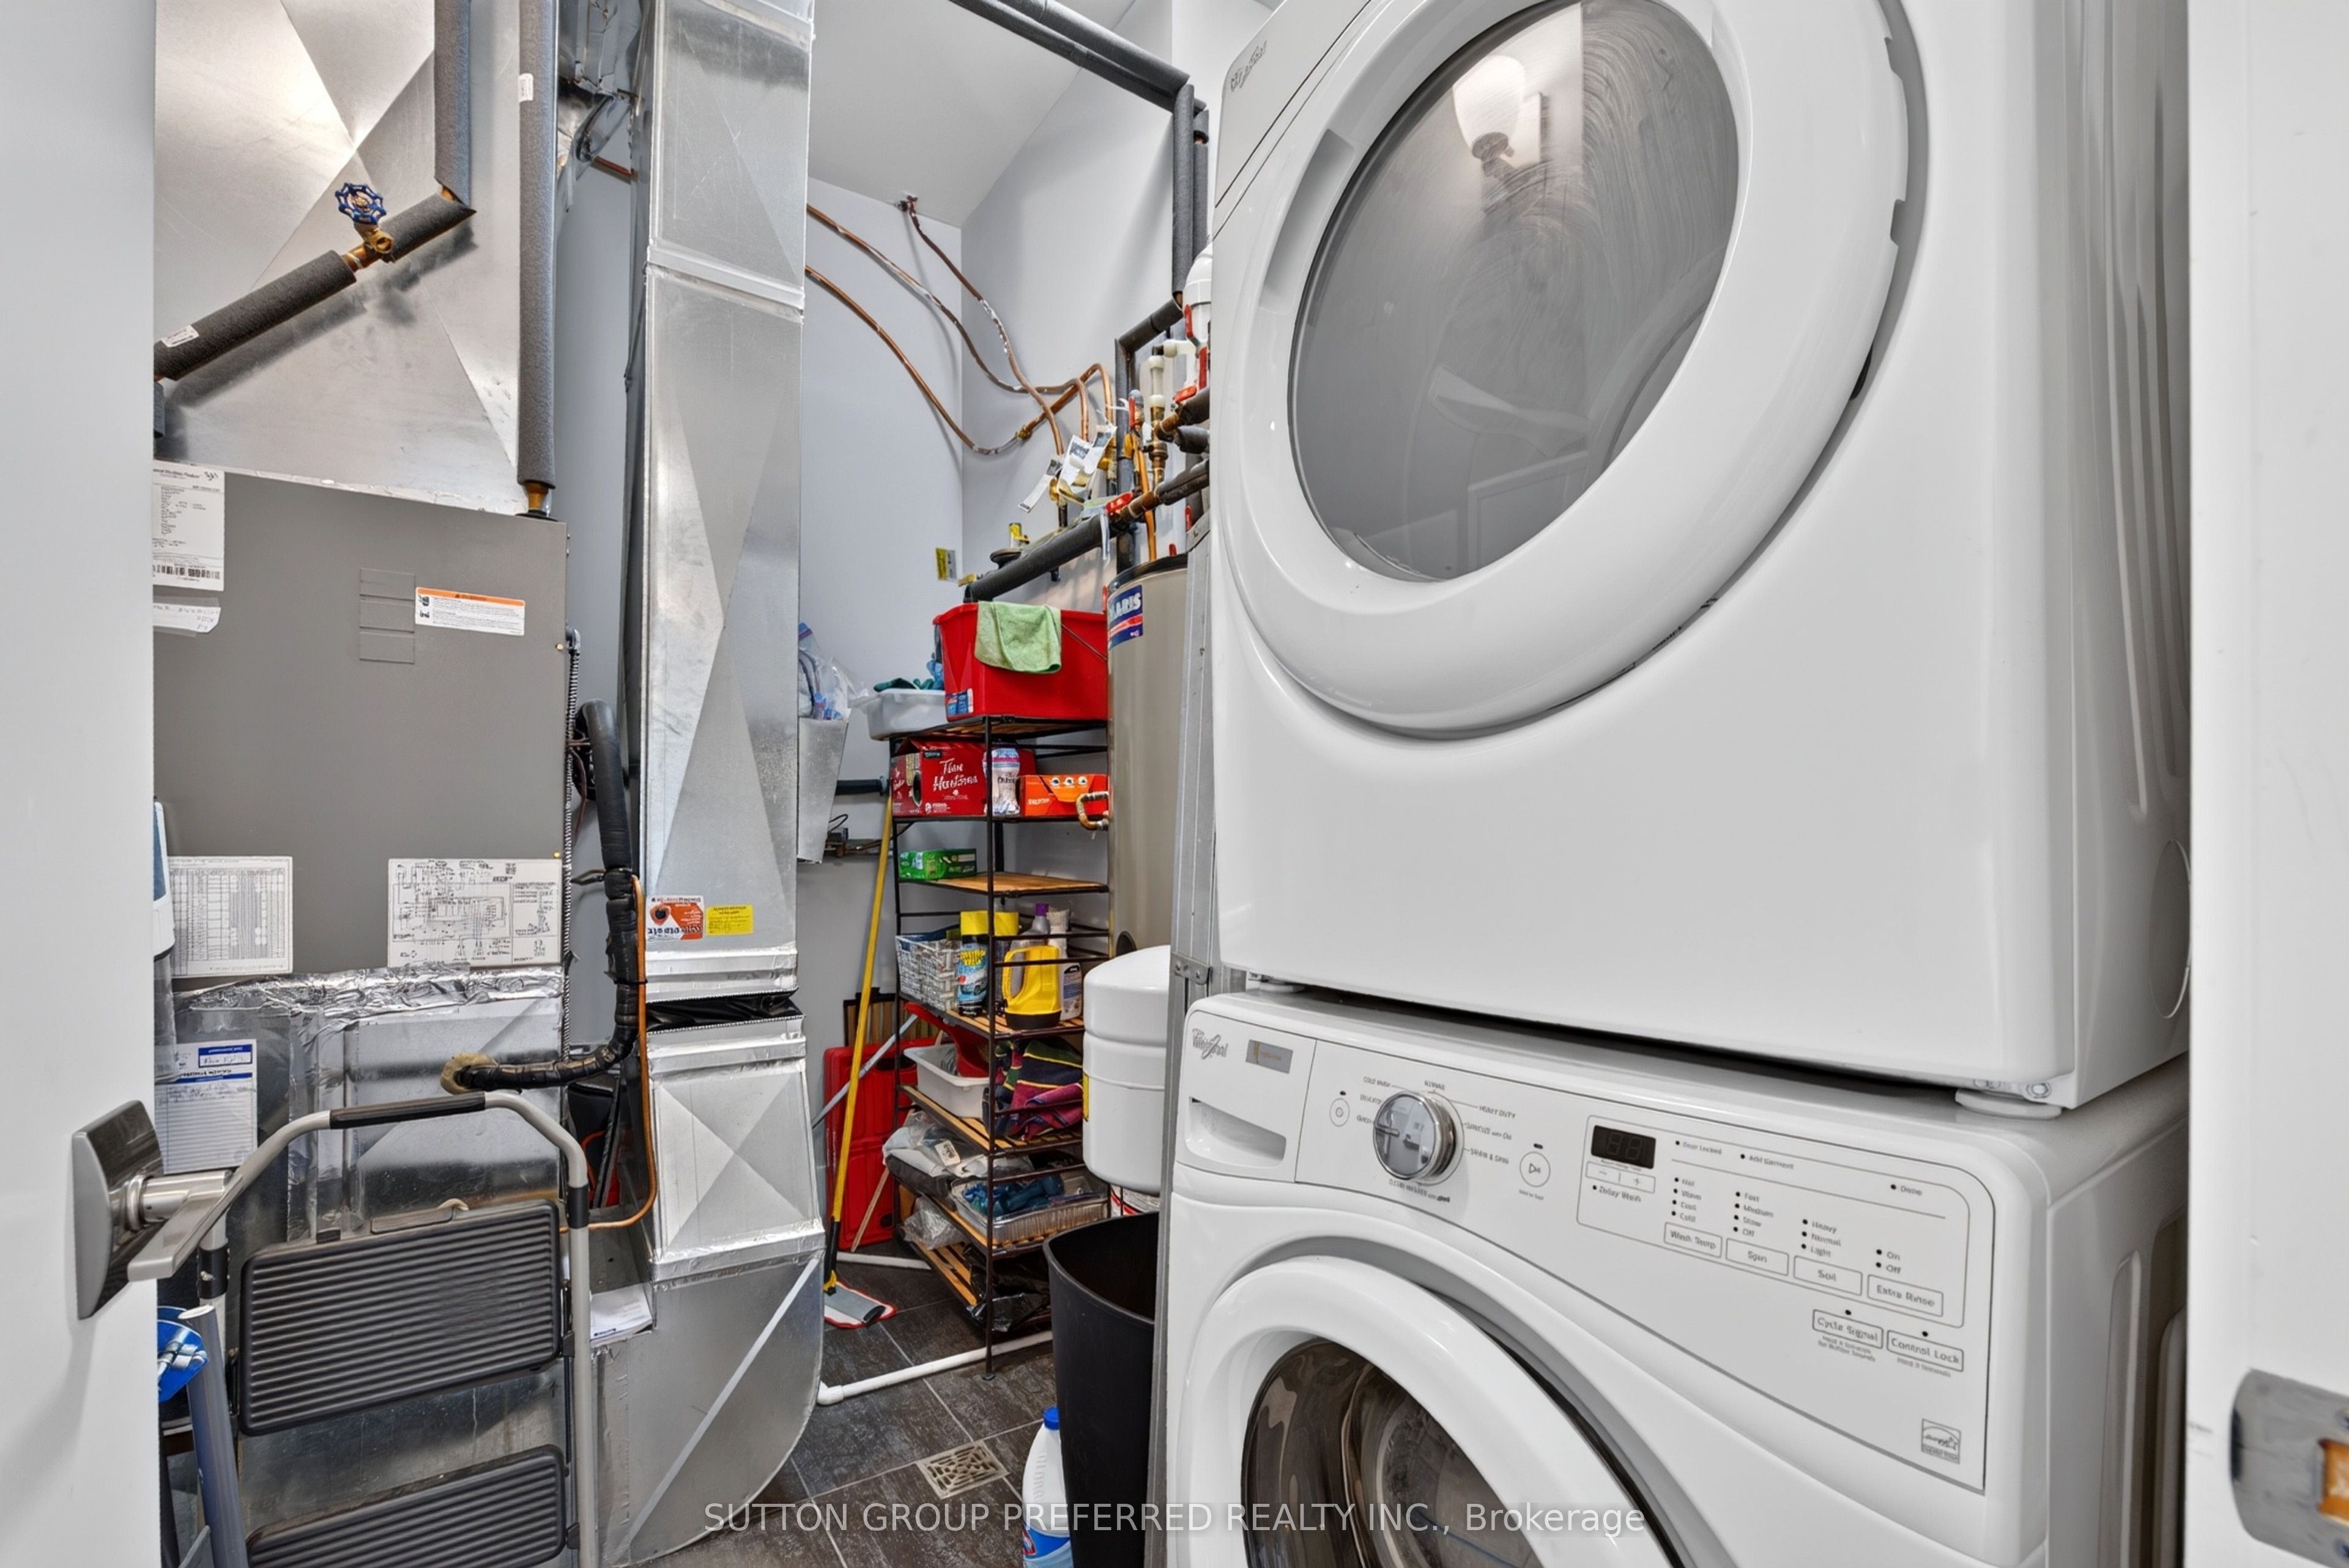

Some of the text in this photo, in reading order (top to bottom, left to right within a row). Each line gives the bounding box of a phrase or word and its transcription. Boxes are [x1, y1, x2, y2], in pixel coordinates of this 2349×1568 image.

[1817, 1269, 1837, 1282] Soil
[1876, 1284, 1935, 1307] Extra Rinse
[1817, 1317, 1879, 1342] Cycle Signal
[1891, 1337, 1931, 1356] Control
[1933, 1347, 1959, 1364] Lock
